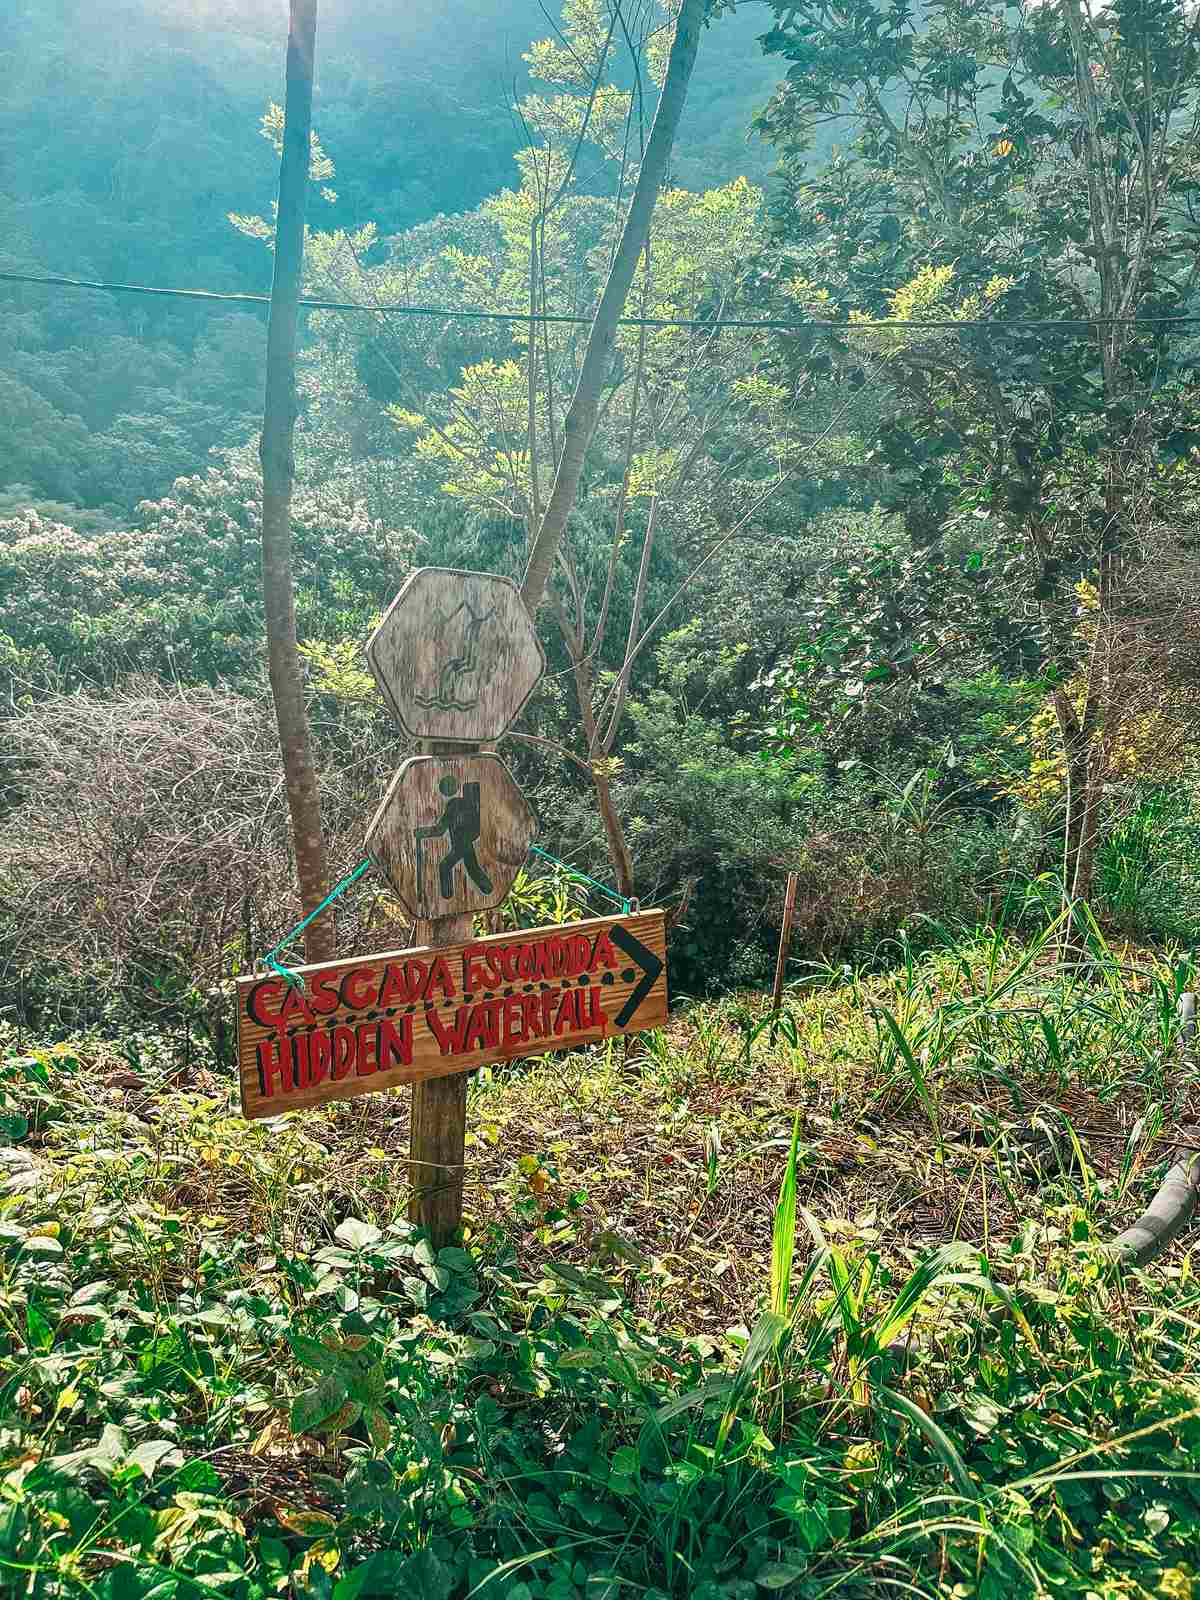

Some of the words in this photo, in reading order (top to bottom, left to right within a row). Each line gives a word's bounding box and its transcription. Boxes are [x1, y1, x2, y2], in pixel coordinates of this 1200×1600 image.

[247, 957, 456, 1028] CASCADA
[463, 930, 620, 993] ESCONDIDA
[256, 1014, 414, 1097] HIDDEN
[426, 987, 609, 1056] WATERFALL
